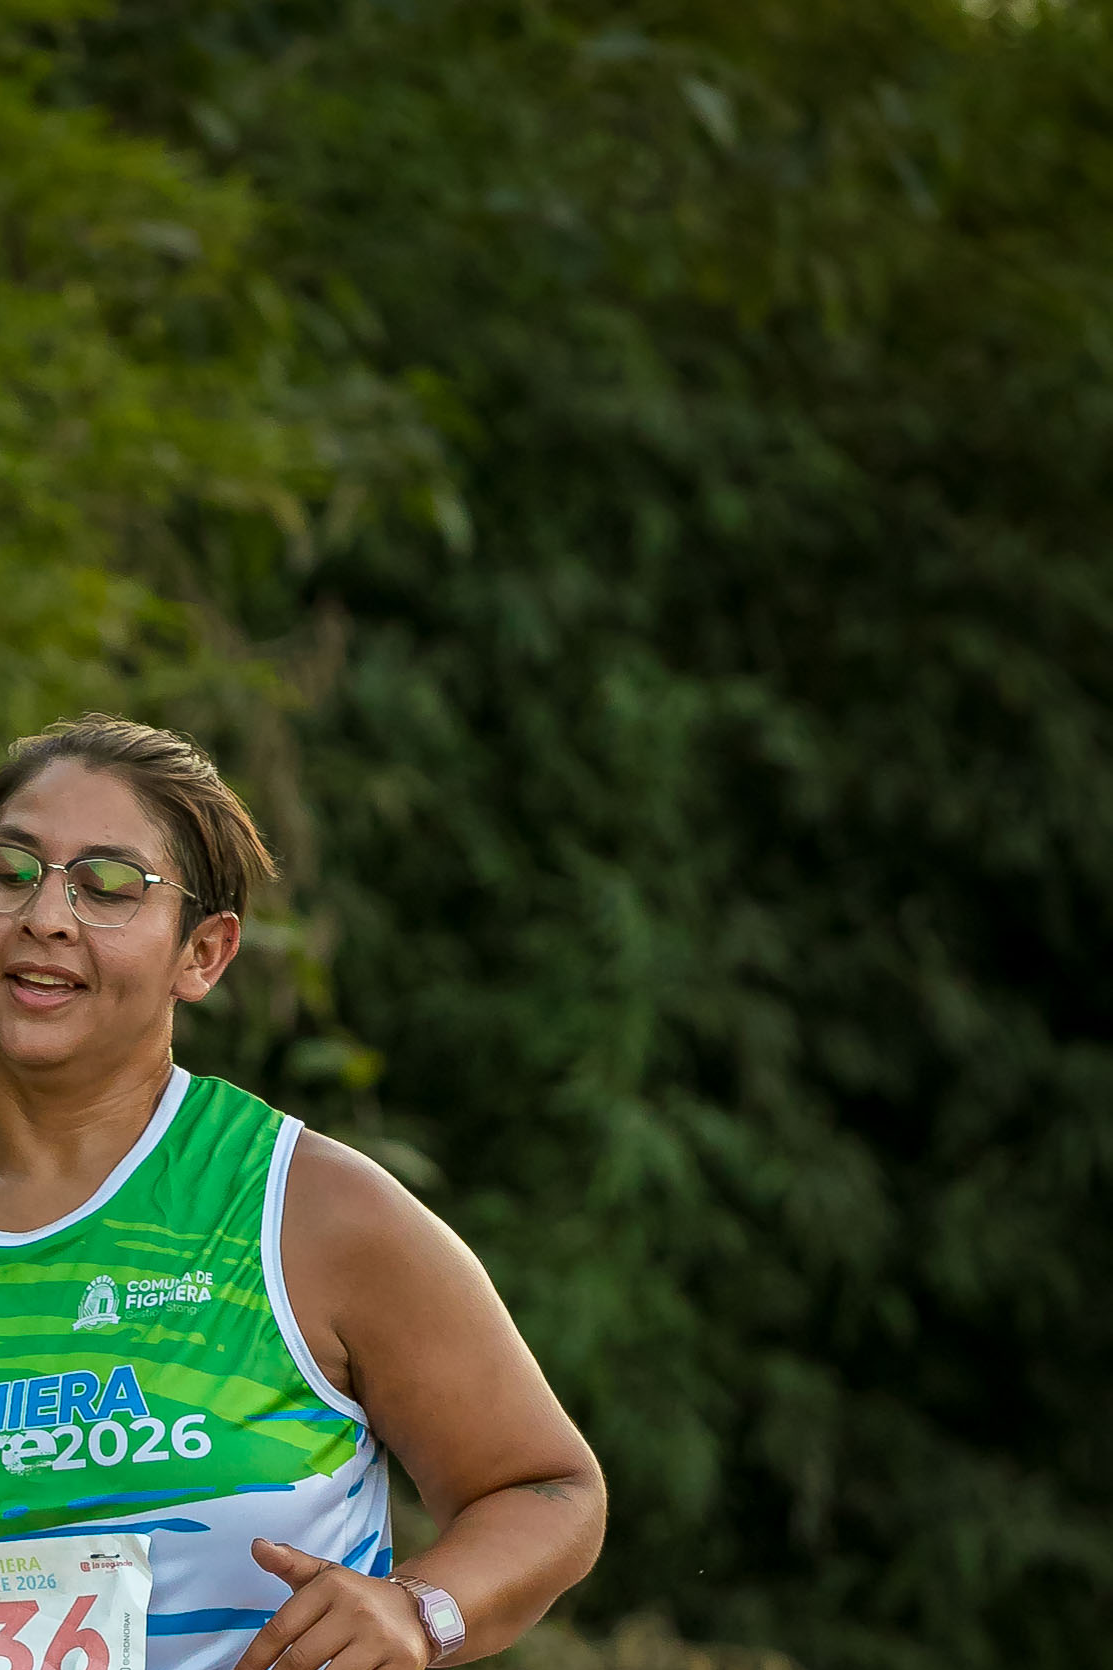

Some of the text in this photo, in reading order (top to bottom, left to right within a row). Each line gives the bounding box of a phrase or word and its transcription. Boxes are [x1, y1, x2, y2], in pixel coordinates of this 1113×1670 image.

[196, 1270, 214, 1286] DE
[125, 1284, 212, 1310] FIGHIERA
[17, 1573, 57, 1591] 2026
